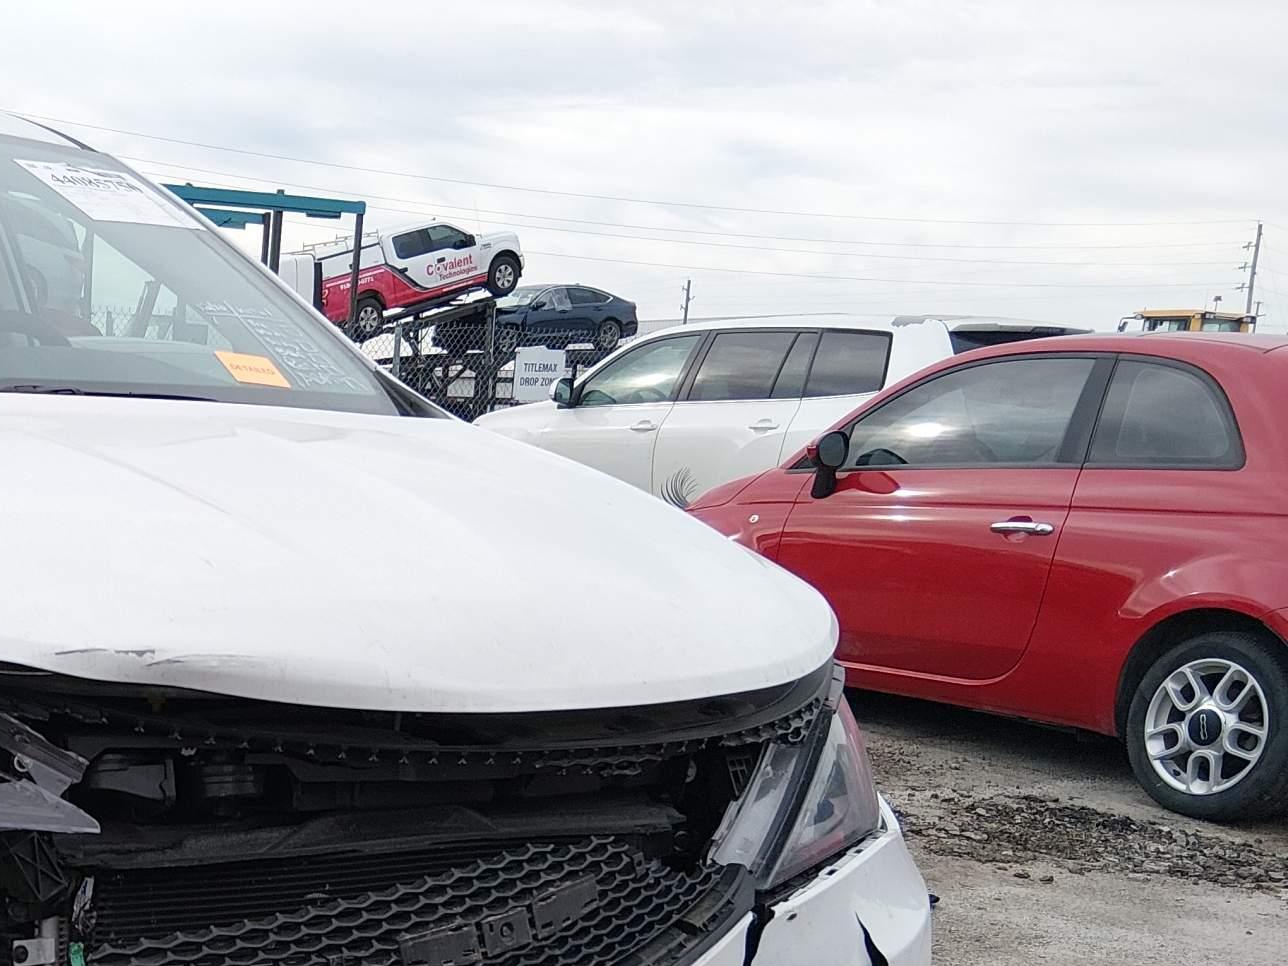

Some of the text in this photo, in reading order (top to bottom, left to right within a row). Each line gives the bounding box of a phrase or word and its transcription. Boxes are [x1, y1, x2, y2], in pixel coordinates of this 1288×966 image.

[426, 253, 473, 276] Covalent
[524, 363, 558, 372] TITLEMAX
[520, 377, 555, 386] DROP ZON
